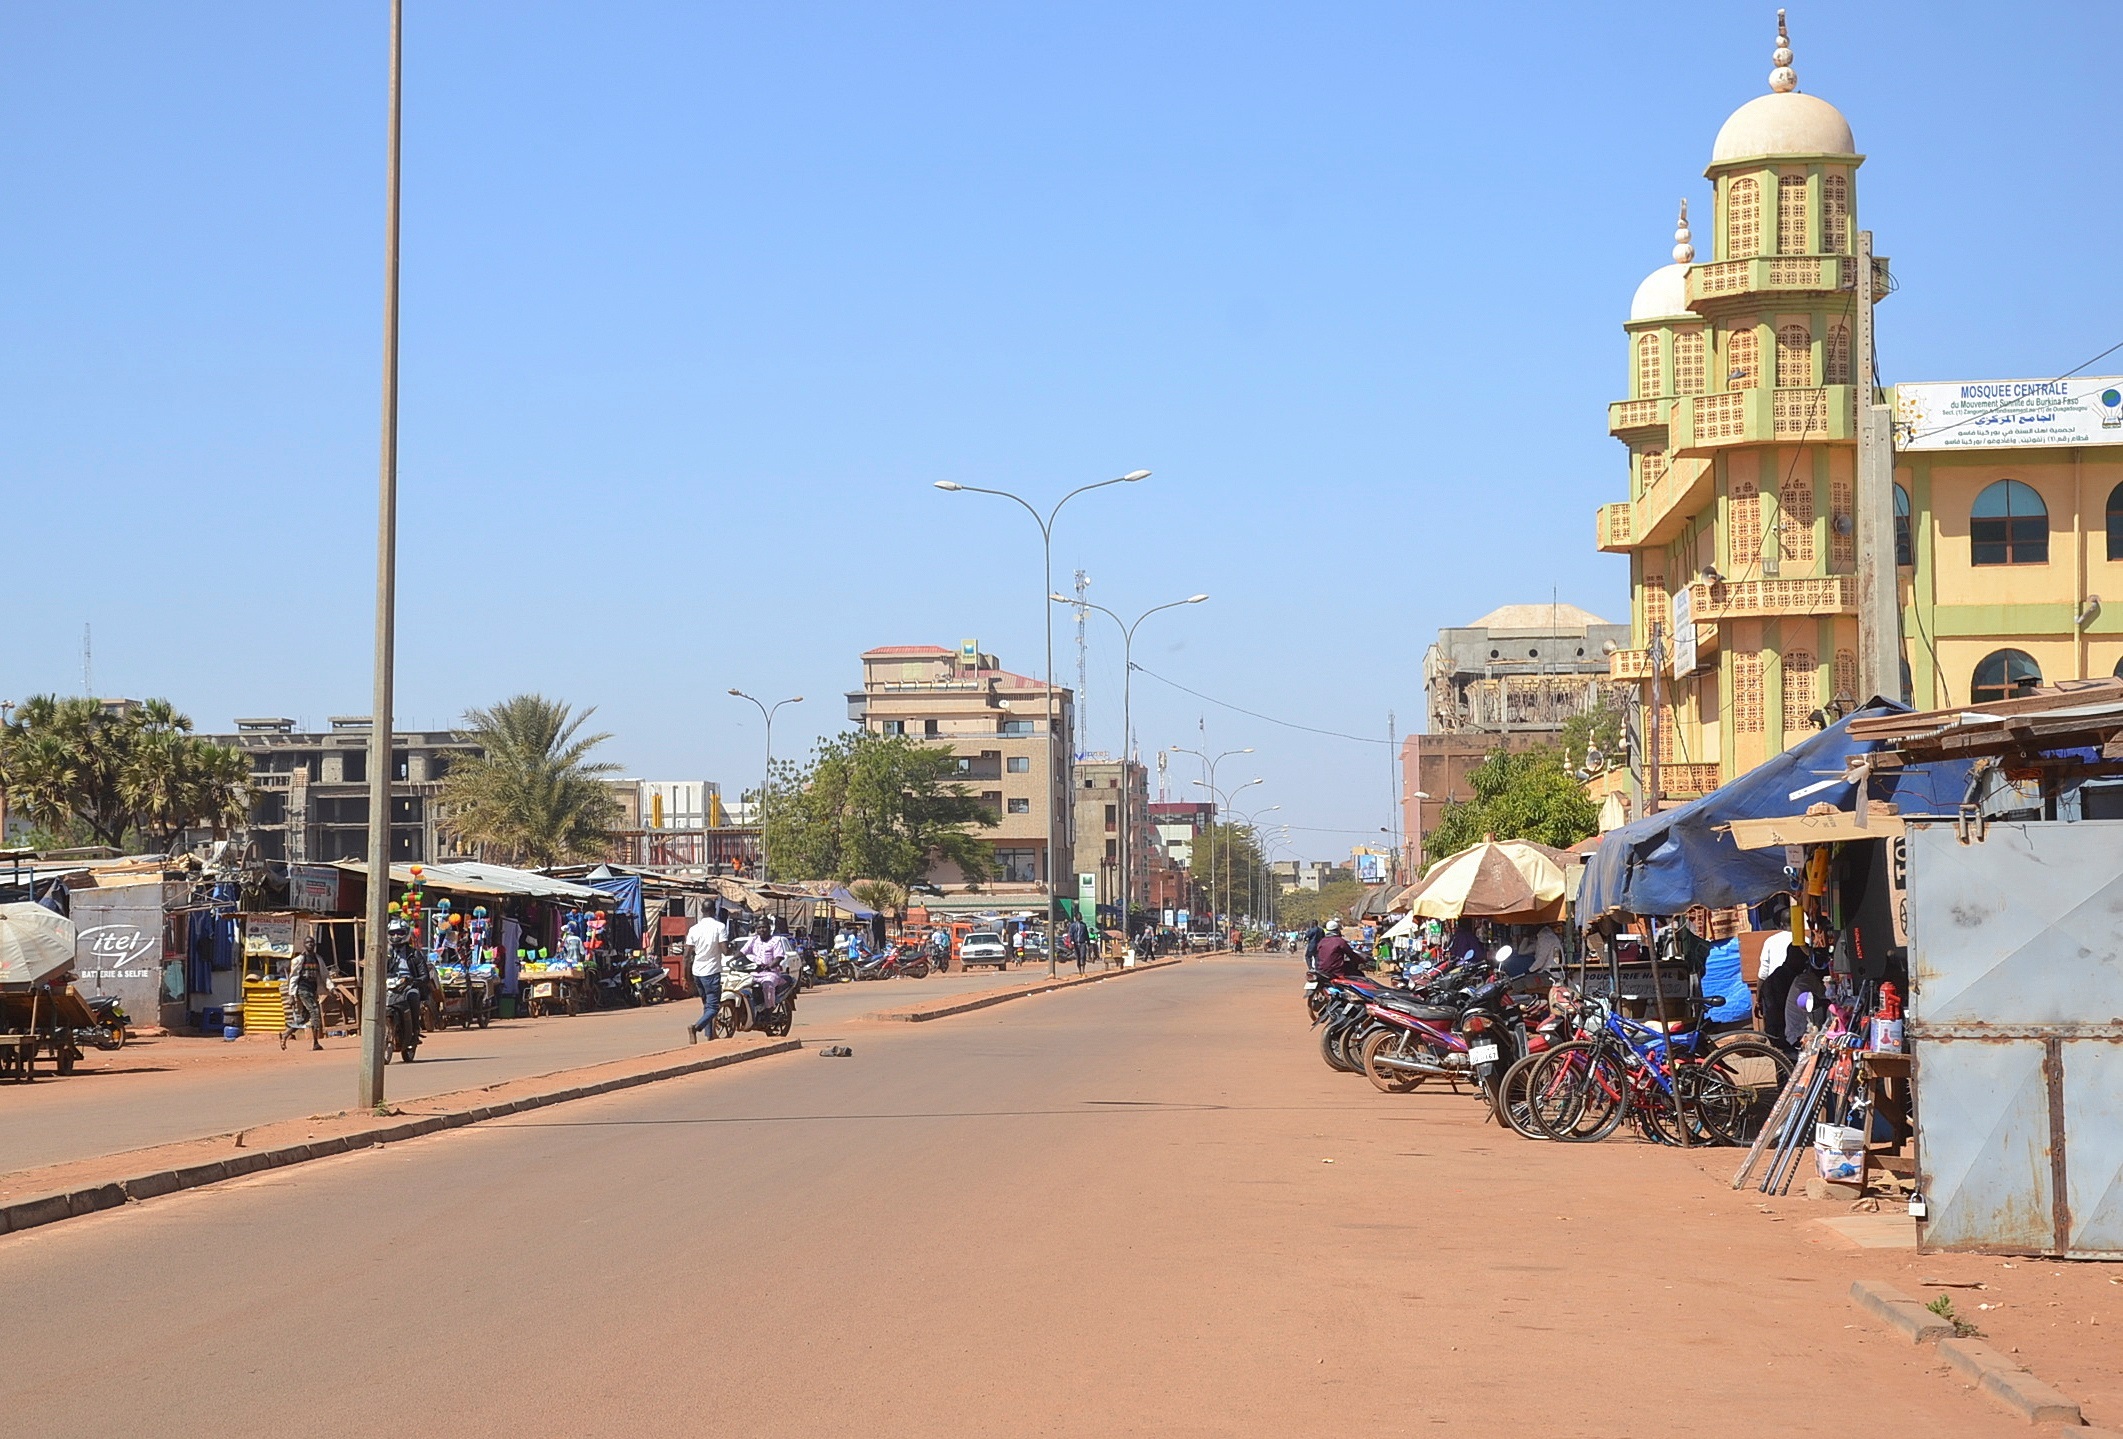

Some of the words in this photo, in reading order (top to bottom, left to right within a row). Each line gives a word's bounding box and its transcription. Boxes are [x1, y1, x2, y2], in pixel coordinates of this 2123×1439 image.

[1961, 385, 2012, 399] MOSQUEE
[2014, 382, 2068, 397] CENTRALE
[1961, 399, 1999, 409] Mouvement
[93, 931, 140, 951] itel
[124, 970, 149, 978] SELFIE
[1642, 971, 1674, 980] HAAL
